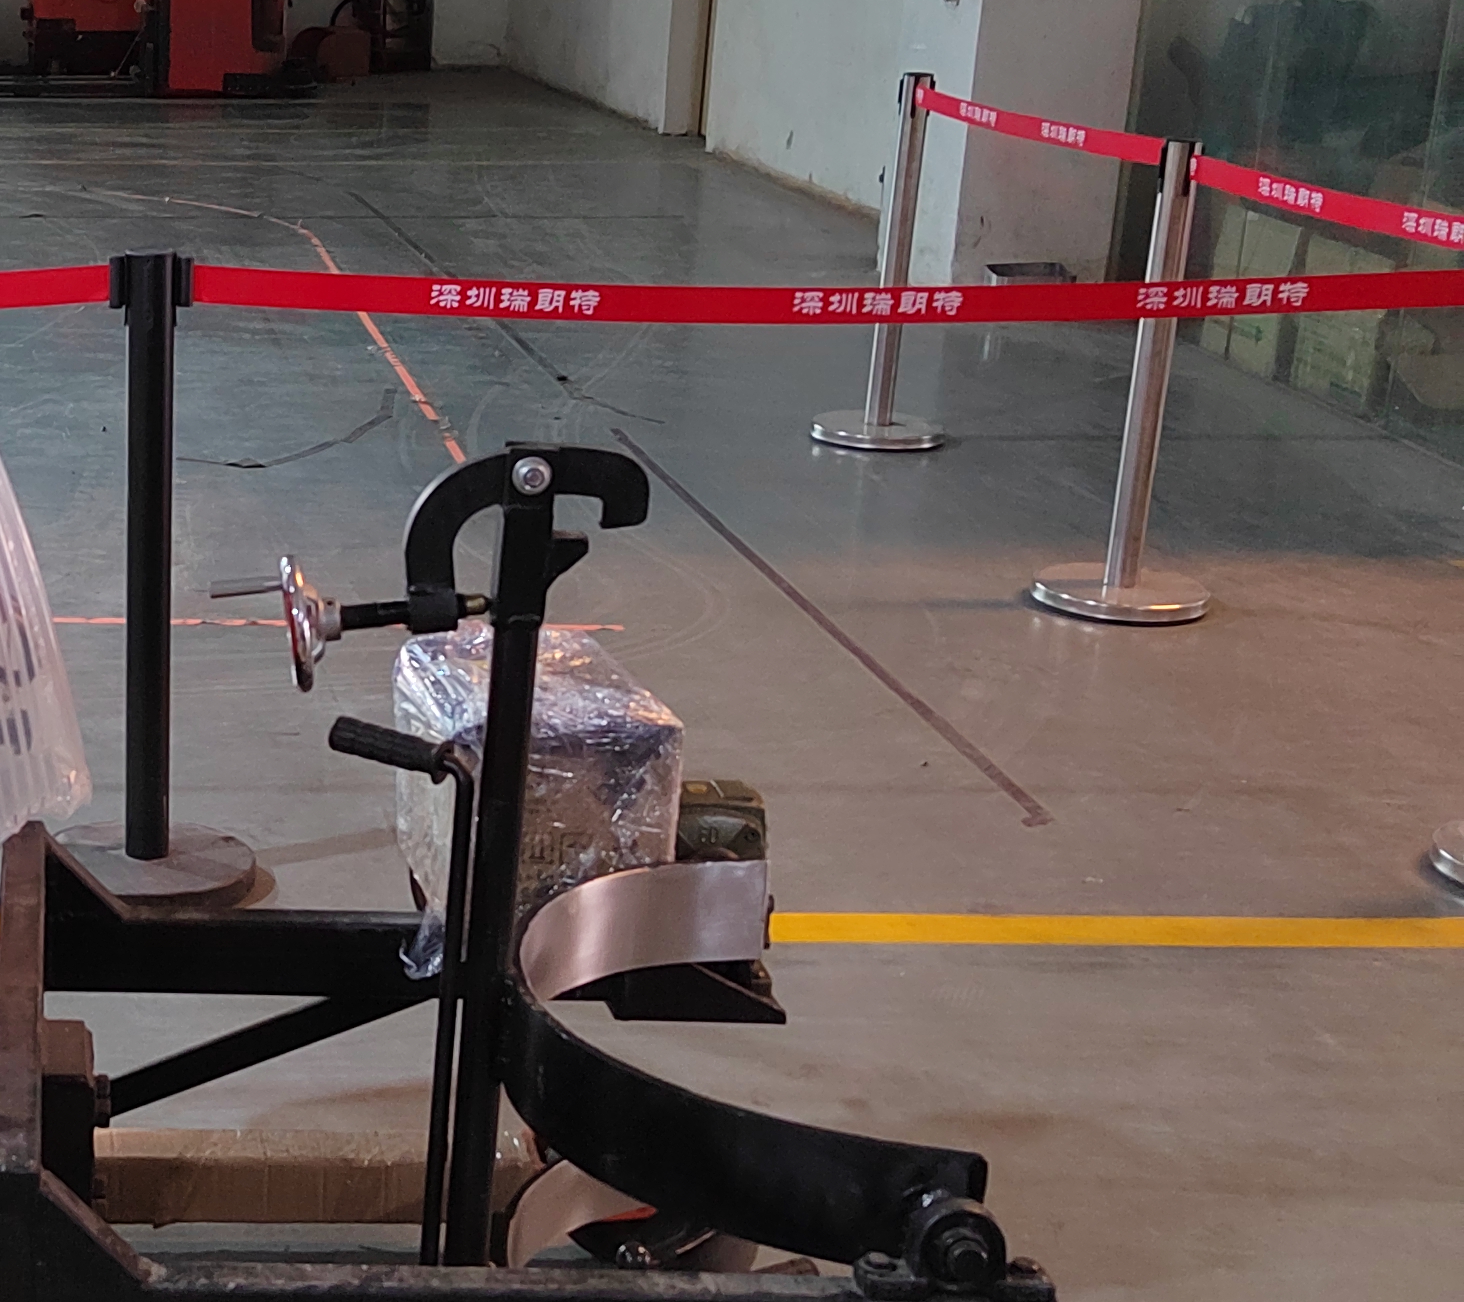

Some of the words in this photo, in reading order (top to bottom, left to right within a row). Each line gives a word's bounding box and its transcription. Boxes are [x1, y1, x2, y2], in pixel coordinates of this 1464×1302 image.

[429, 284, 601, 316] 深圳瑞朗特
[792, 290, 964, 316] 深圳瑞朗特
[1136, 281, 1310, 311] 深圳瑞朗特
